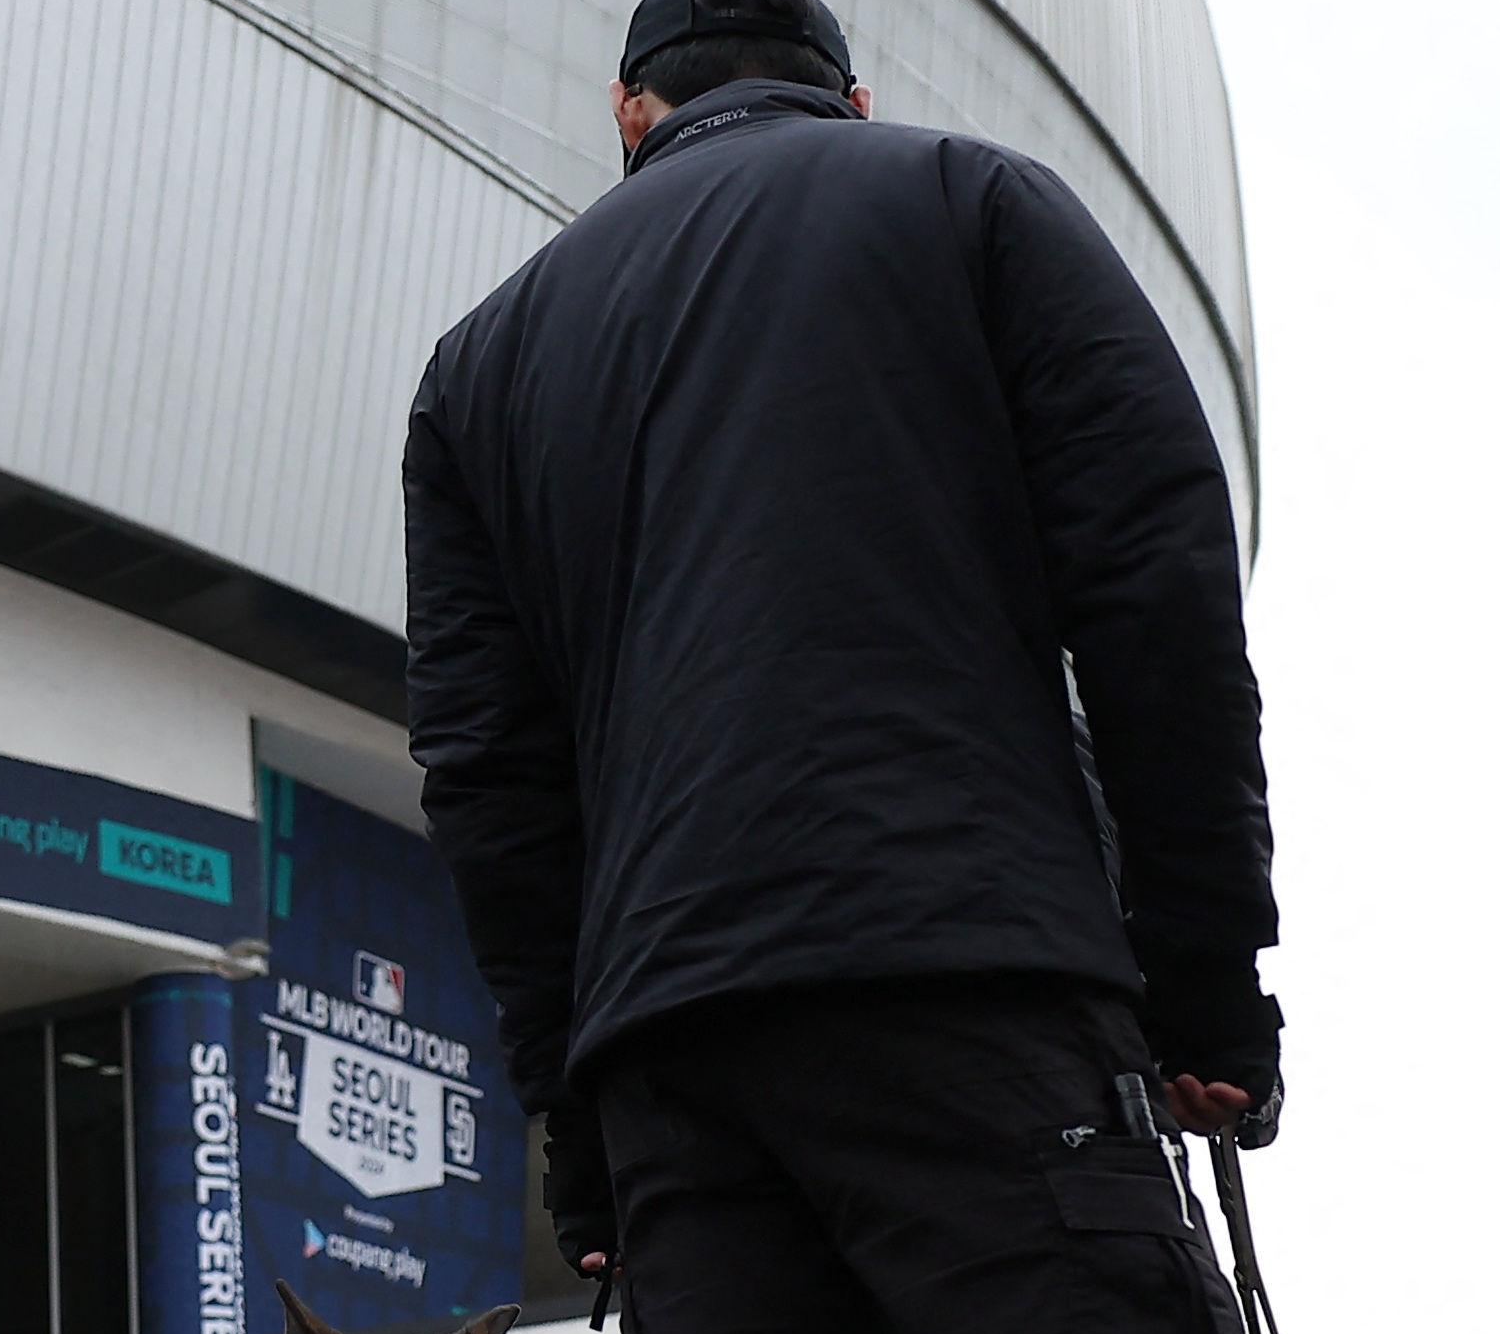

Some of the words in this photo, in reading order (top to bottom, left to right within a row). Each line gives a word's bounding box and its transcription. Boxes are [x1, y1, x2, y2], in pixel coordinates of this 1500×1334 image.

[35, 817, 89, 864] play
[118, 837, 216, 888] KOREA
[277, 978, 329, 1030] MLB
[329, 996, 413, 1057] WORLD
[412, 1027, 470, 1079] TOUR
[332, 1057, 416, 1118] SEOUL
[190, 1042, 233, 1205] SEOUL
[328, 1101, 417, 1162] SERIES
[326, 1234, 394, 1282] coupang
